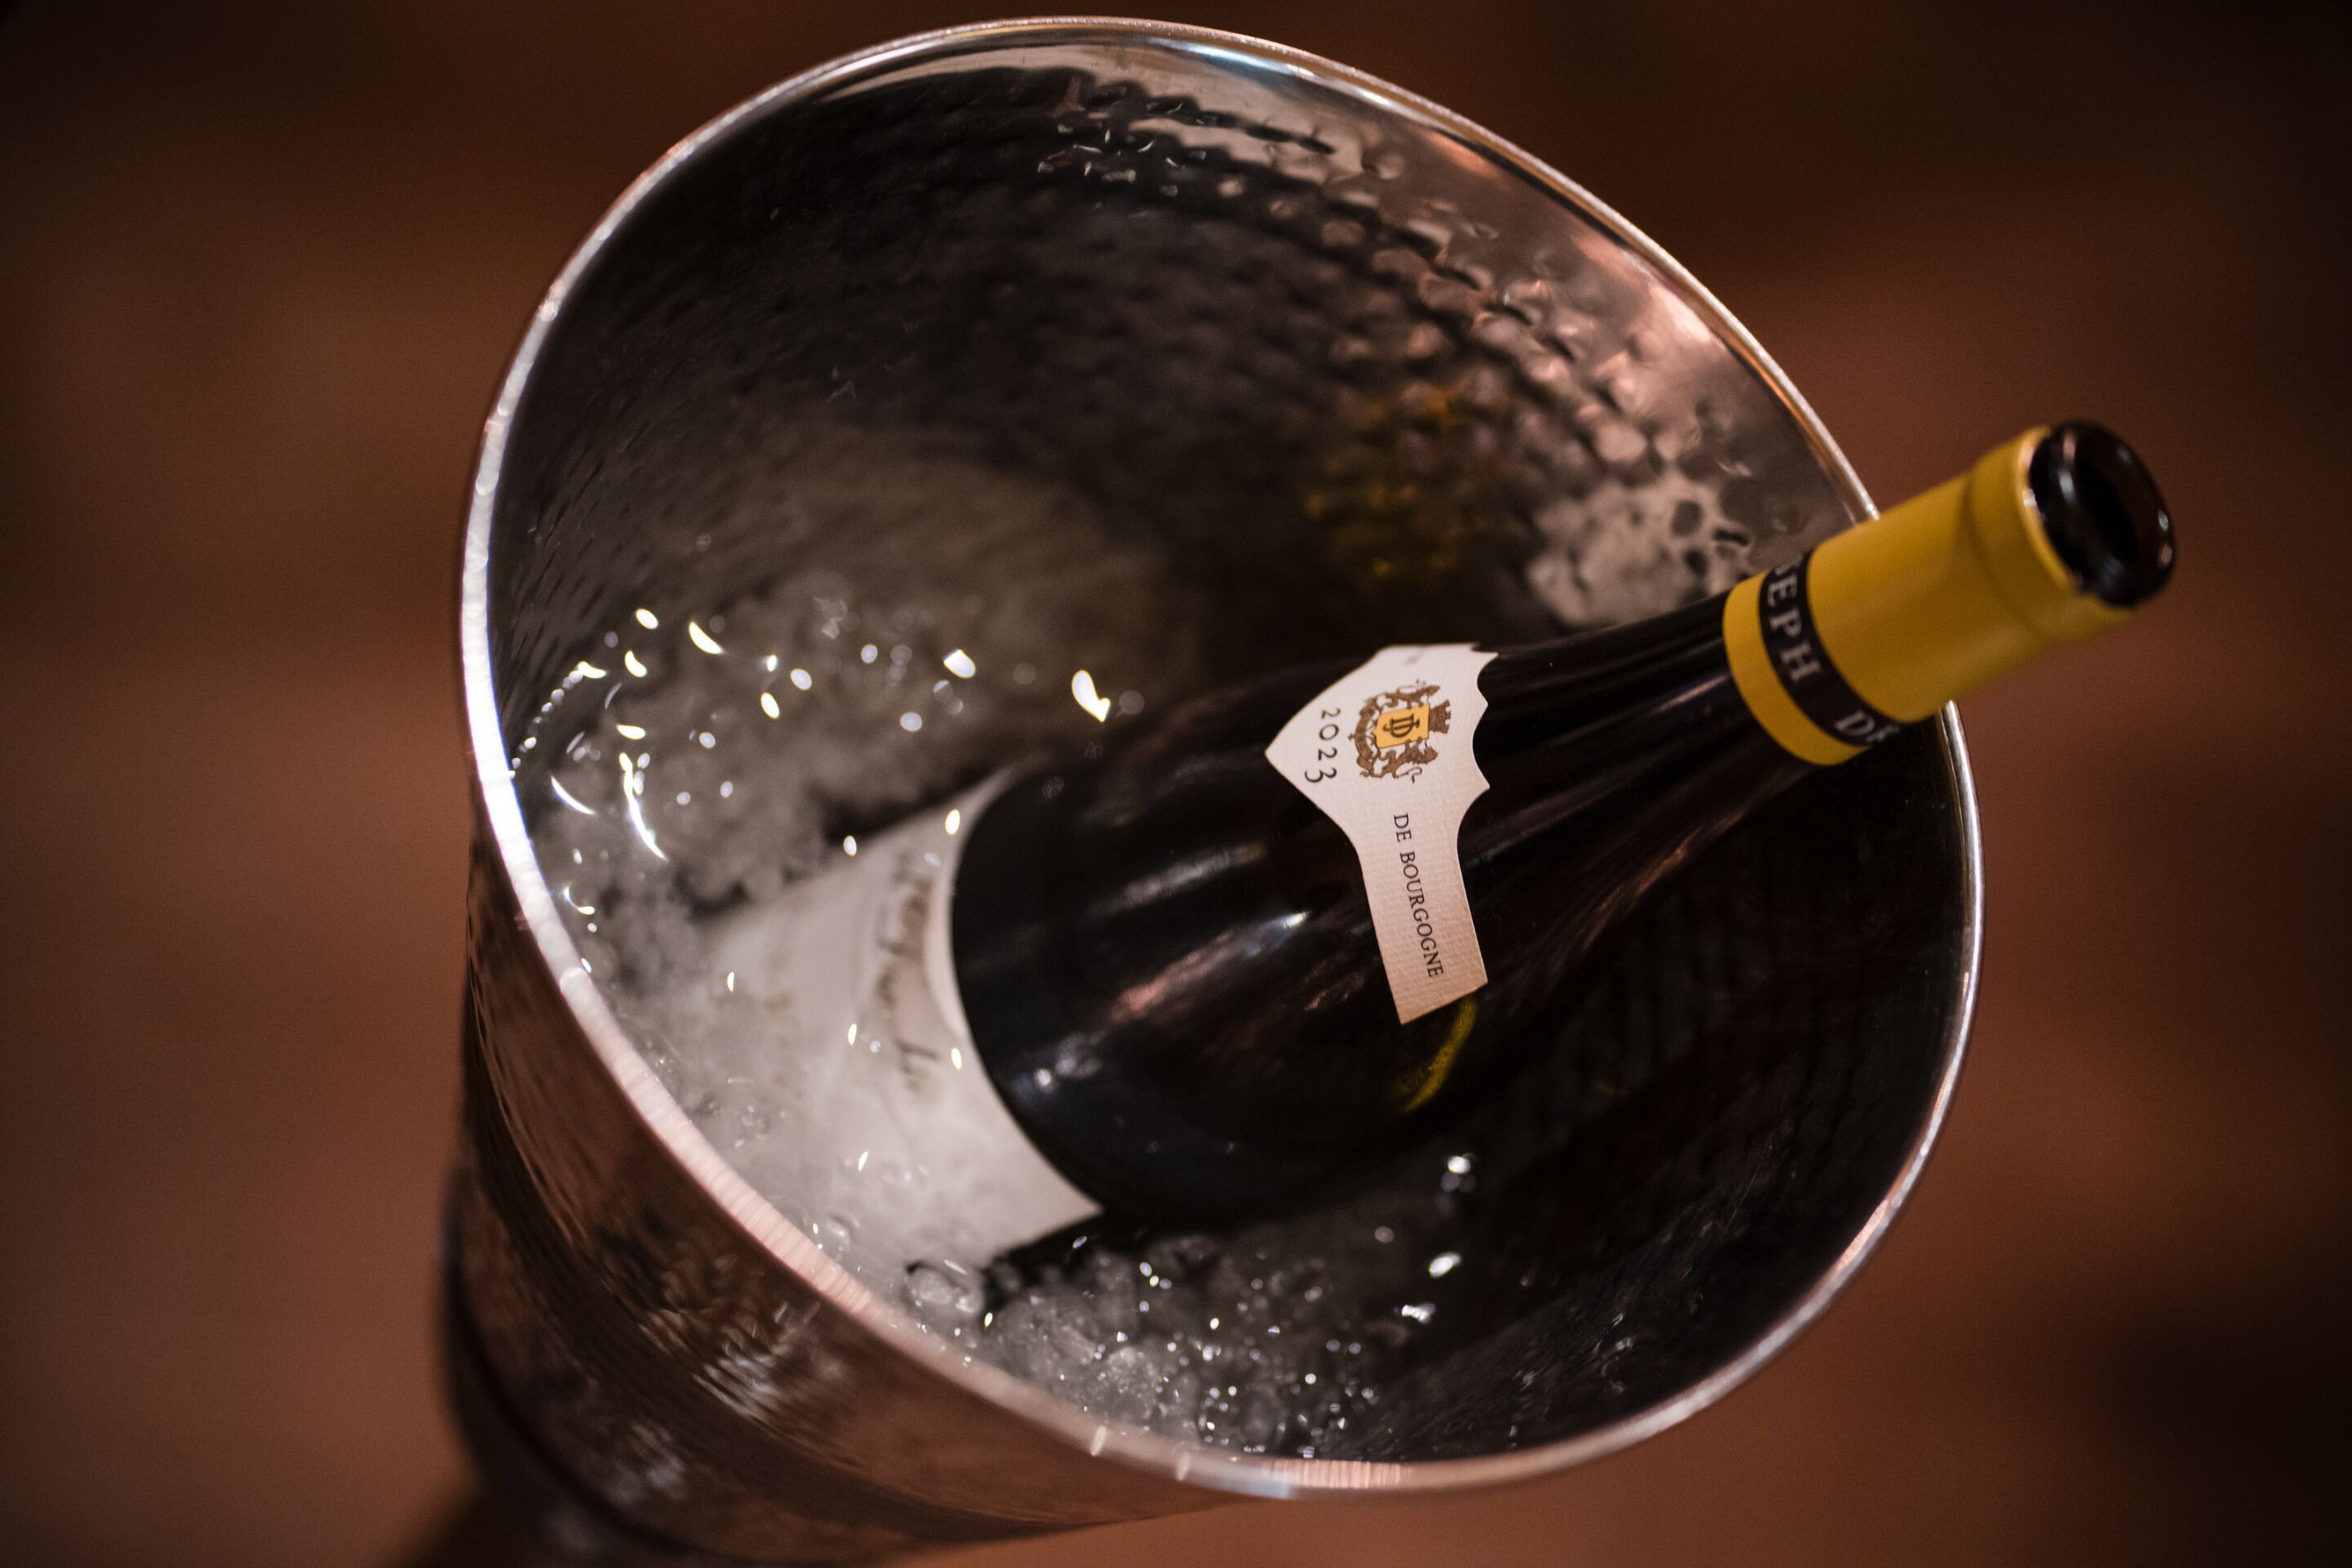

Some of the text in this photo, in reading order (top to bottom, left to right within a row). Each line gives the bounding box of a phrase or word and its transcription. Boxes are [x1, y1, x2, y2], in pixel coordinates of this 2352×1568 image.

[1305, 708, 1341, 784] 2023
[1394, 812, 1444, 978] DE BOURGOGNE
